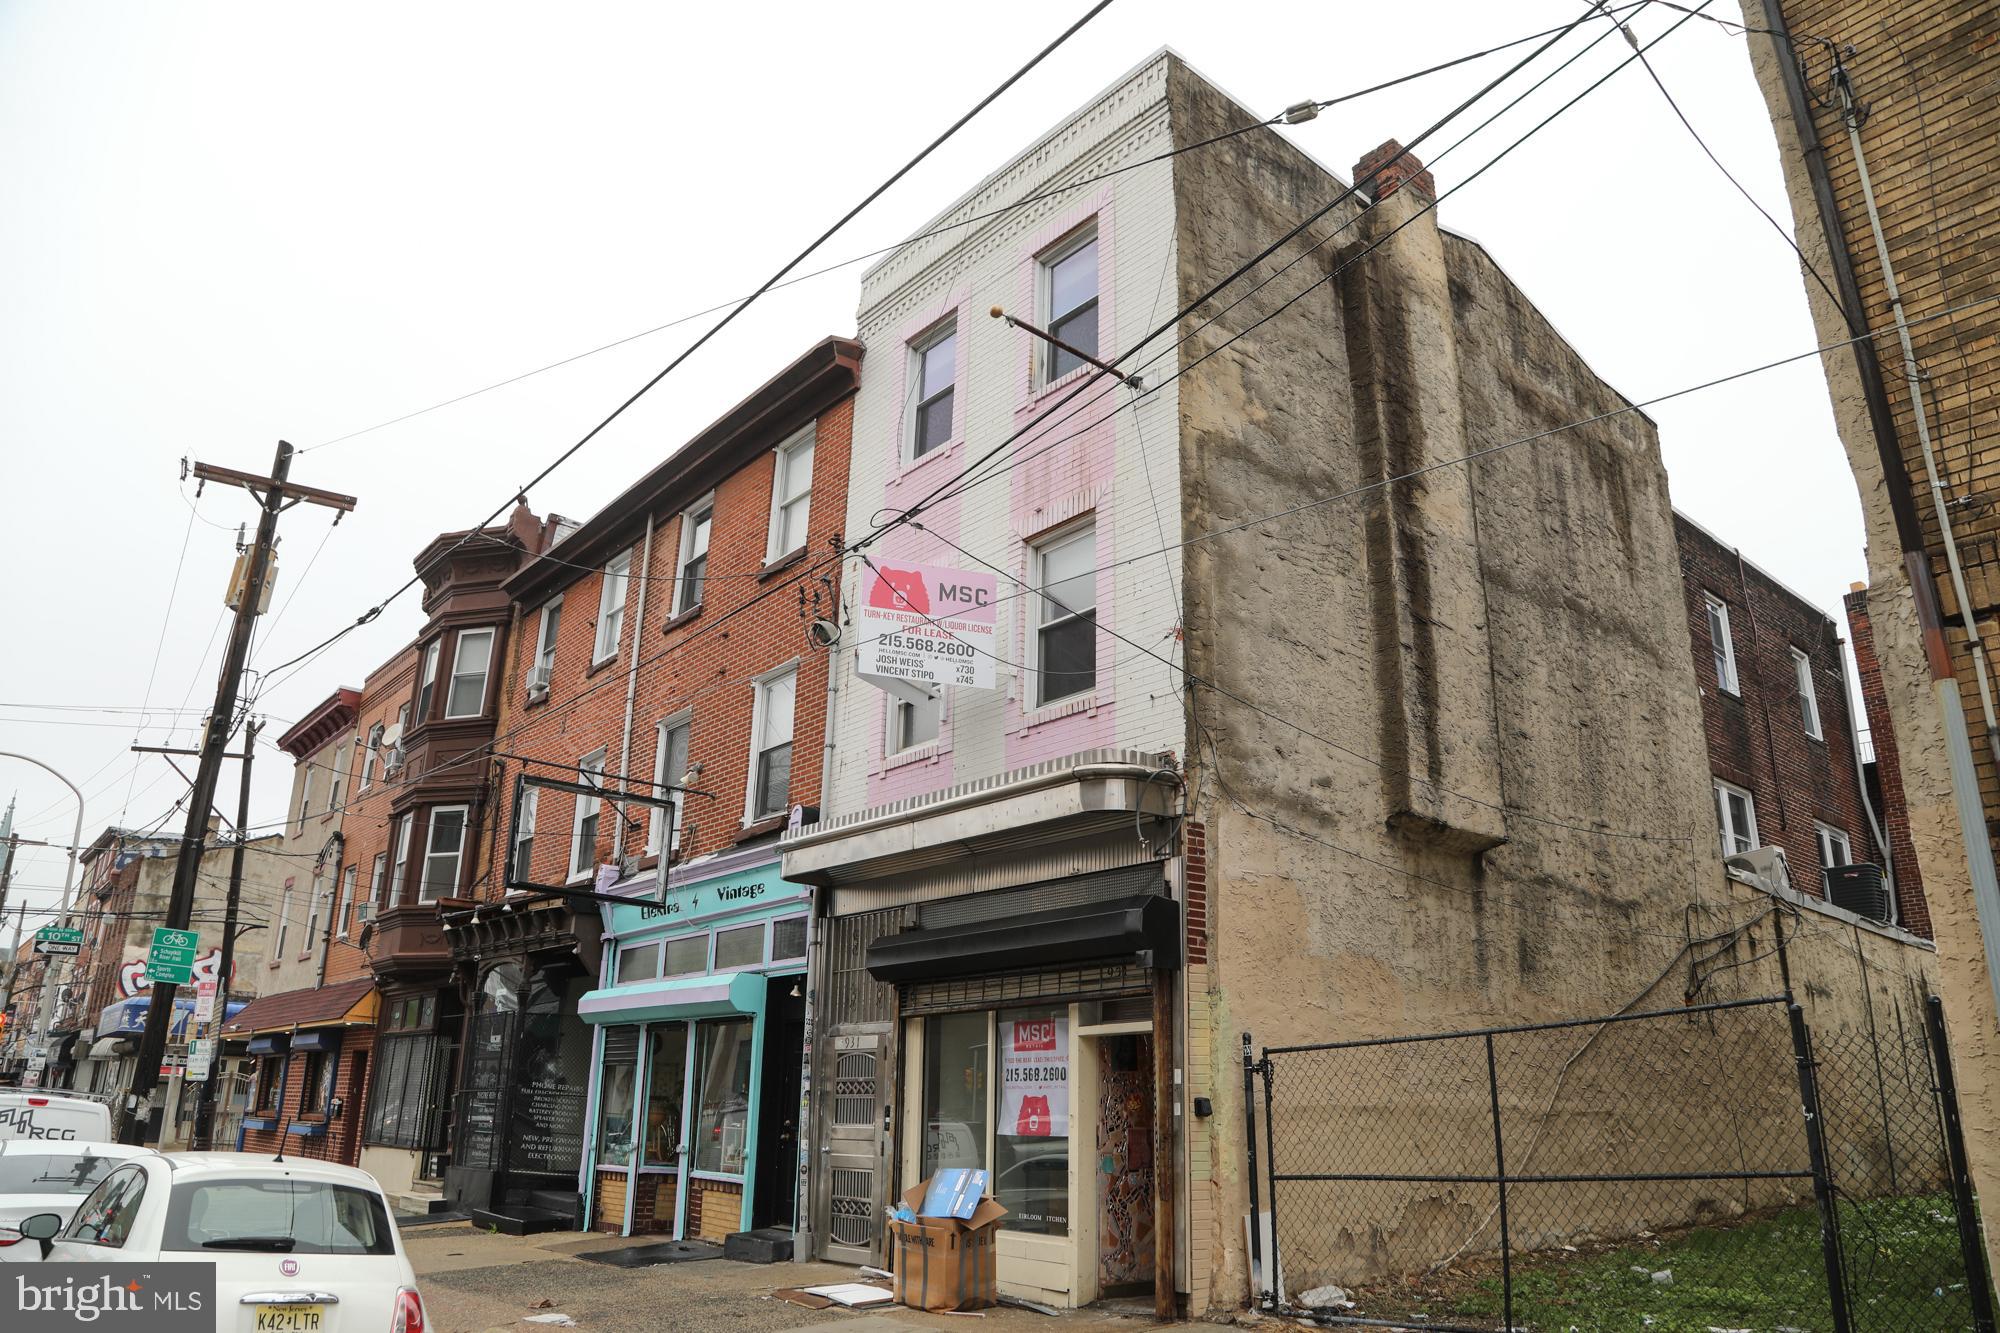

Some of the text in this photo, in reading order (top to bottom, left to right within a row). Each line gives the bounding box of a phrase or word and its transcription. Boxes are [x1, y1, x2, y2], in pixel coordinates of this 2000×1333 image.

[939, 583, 988, 607] MSC
[864, 609, 895, 622] TURN-KEY
[896, 612, 937, 626] RESTAURANT
[968, 623, 992, 634] LICENSE
[902, 625, 954, 640] FOR LEASE
[878, 634, 975, 658] 215.568.2600
[878, 648, 920, 658] HELLOMSC.COM
[876, 655, 924, 668] JOSH WEISS
[876, 664, 934, 680] VINCENT STIPO
[956, 666, 974, 675] x730
[956, 676, 974, 685] x745
[717, 883, 765, 901] Vintage
[1019, 1024, 1050, 1043] MSC
[845, 1036, 860, 1048] 931
[1006, 1067, 1066, 1081] 215.568.2600
[29, 1127, 76, 1140] RCG
[528, 1153, 572, 1161] ELECTRONICS
